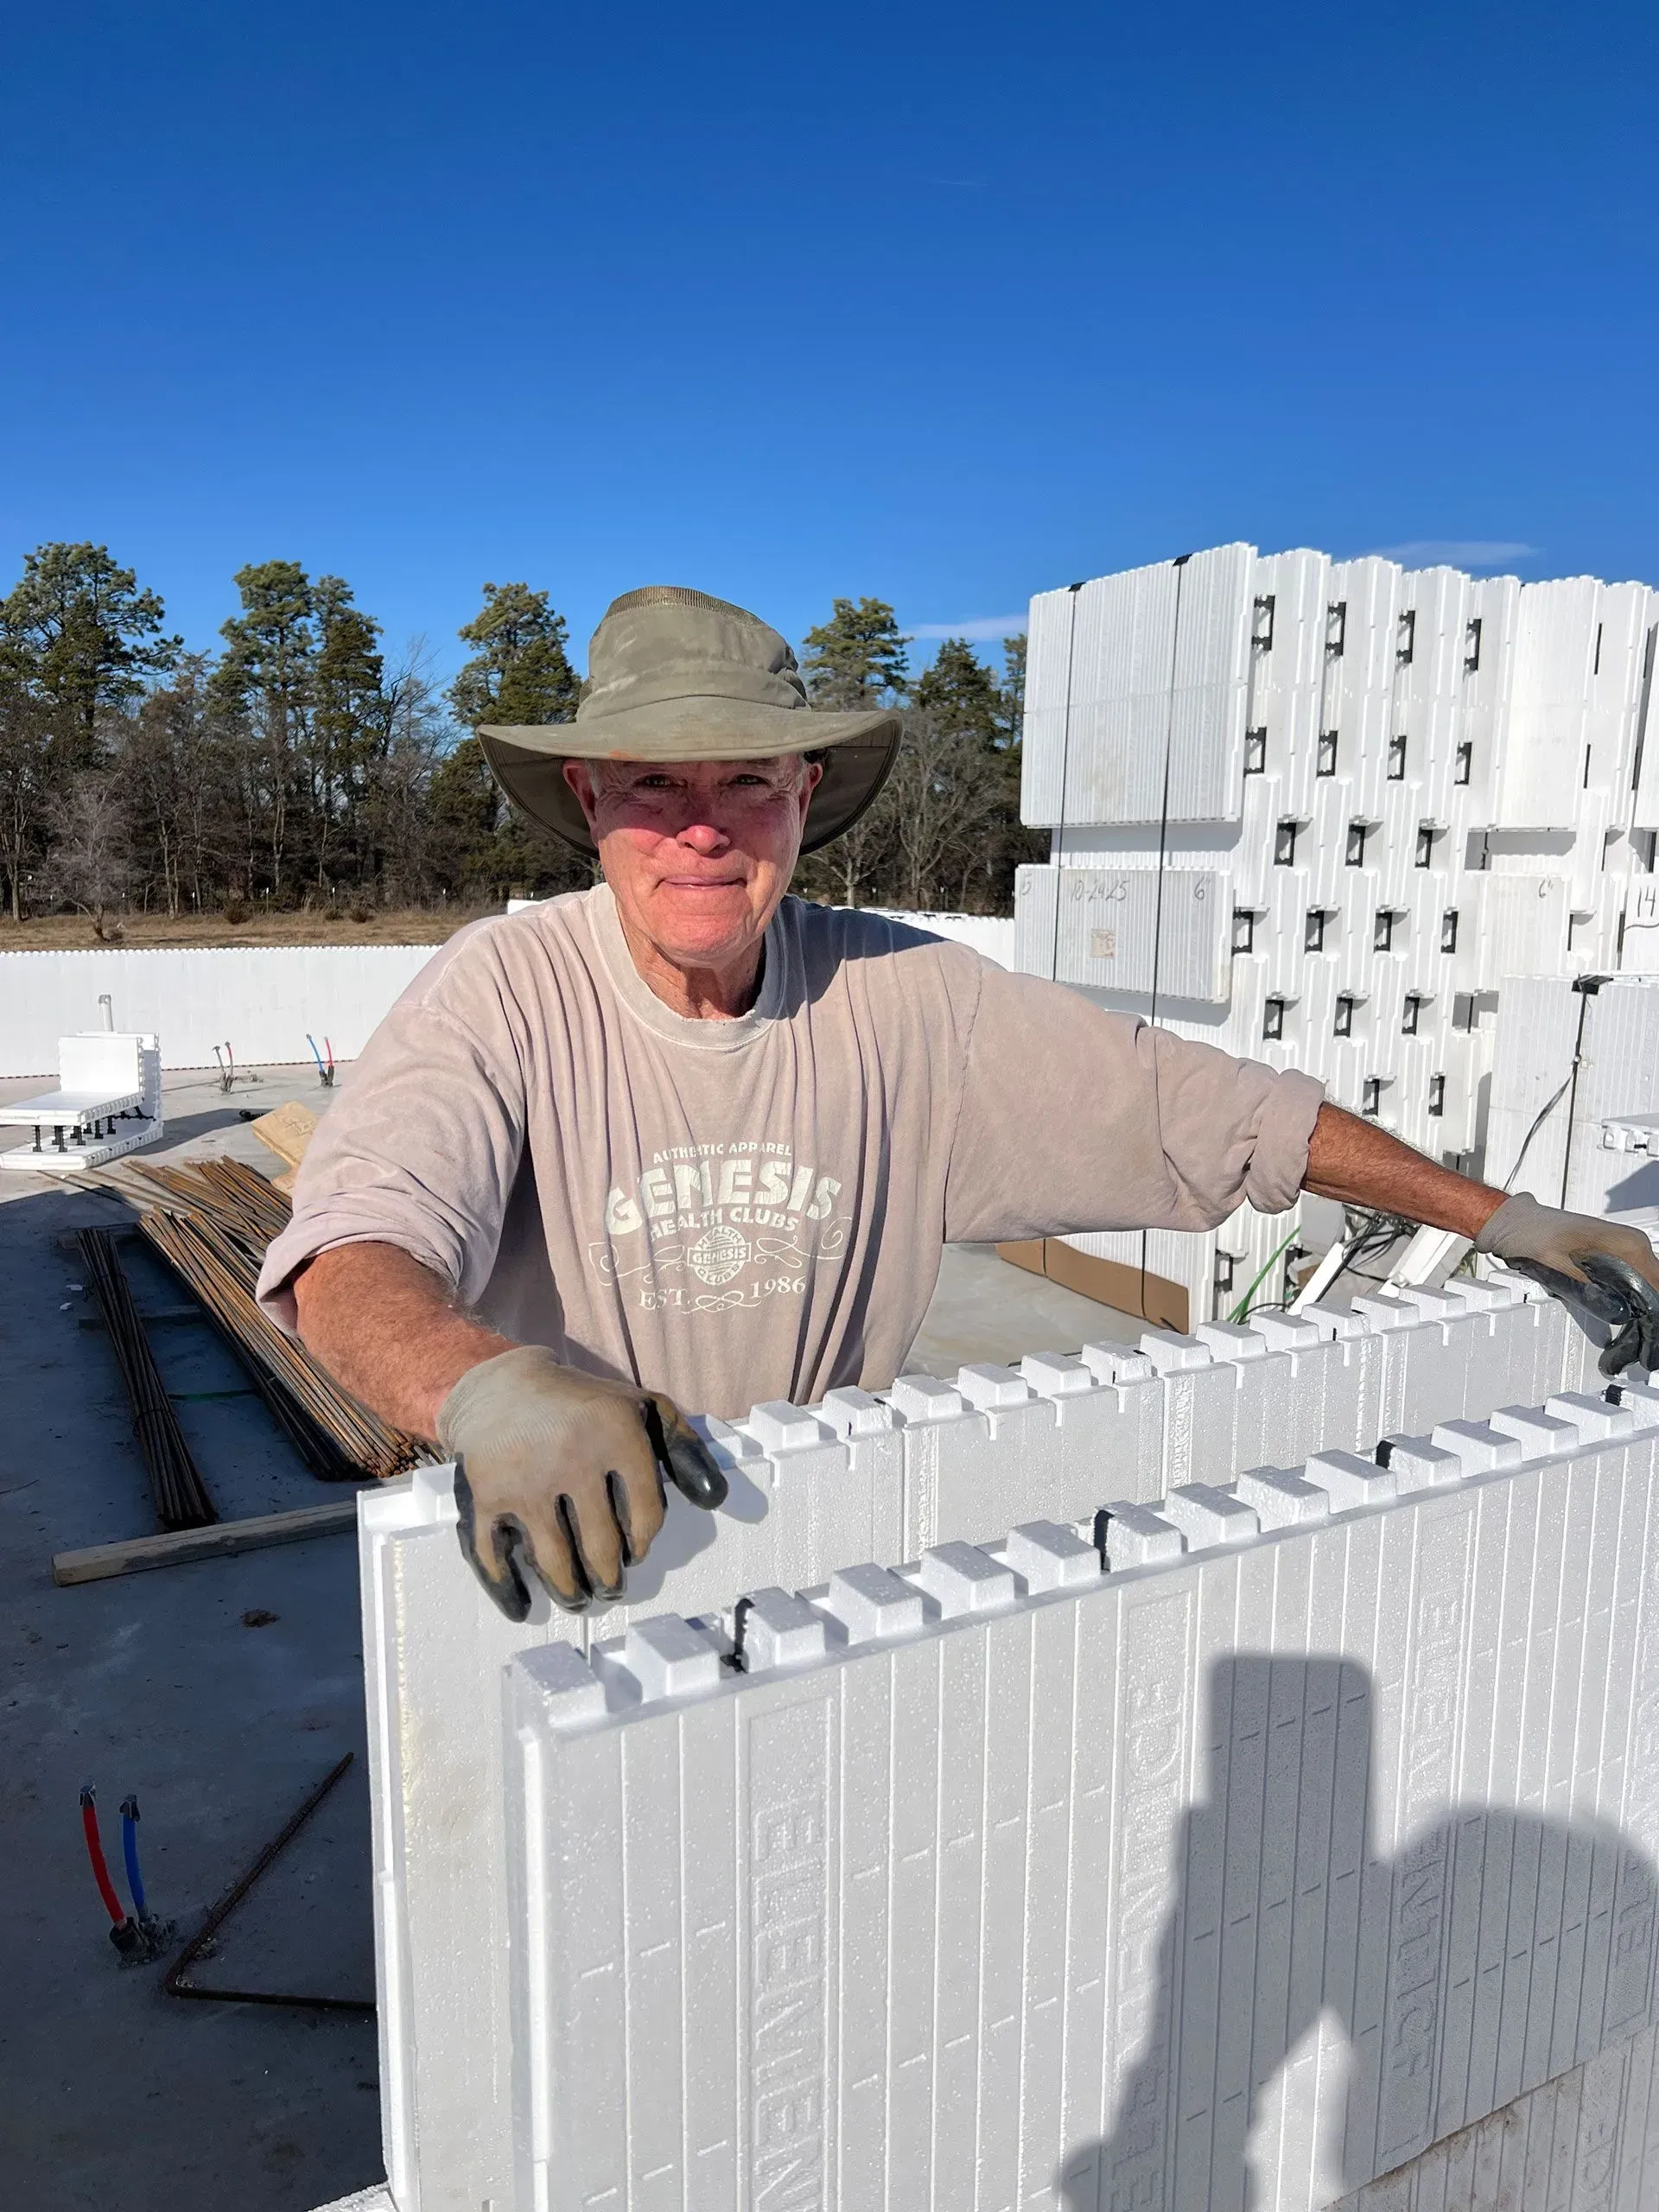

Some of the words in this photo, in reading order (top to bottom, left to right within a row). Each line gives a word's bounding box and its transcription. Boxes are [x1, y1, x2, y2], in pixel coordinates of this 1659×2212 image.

[728, 1141, 792, 1157] APPAREL
[606, 1159, 842, 1236] GENESIS
[651, 1208, 723, 1242] HEALTH
[729, 1206, 799, 1231] CLUBS
[692, 1246, 747, 1265] GENESIS
[639, 1288, 691, 1311] EST.
[750, 1275, 807, 1300] 1986
